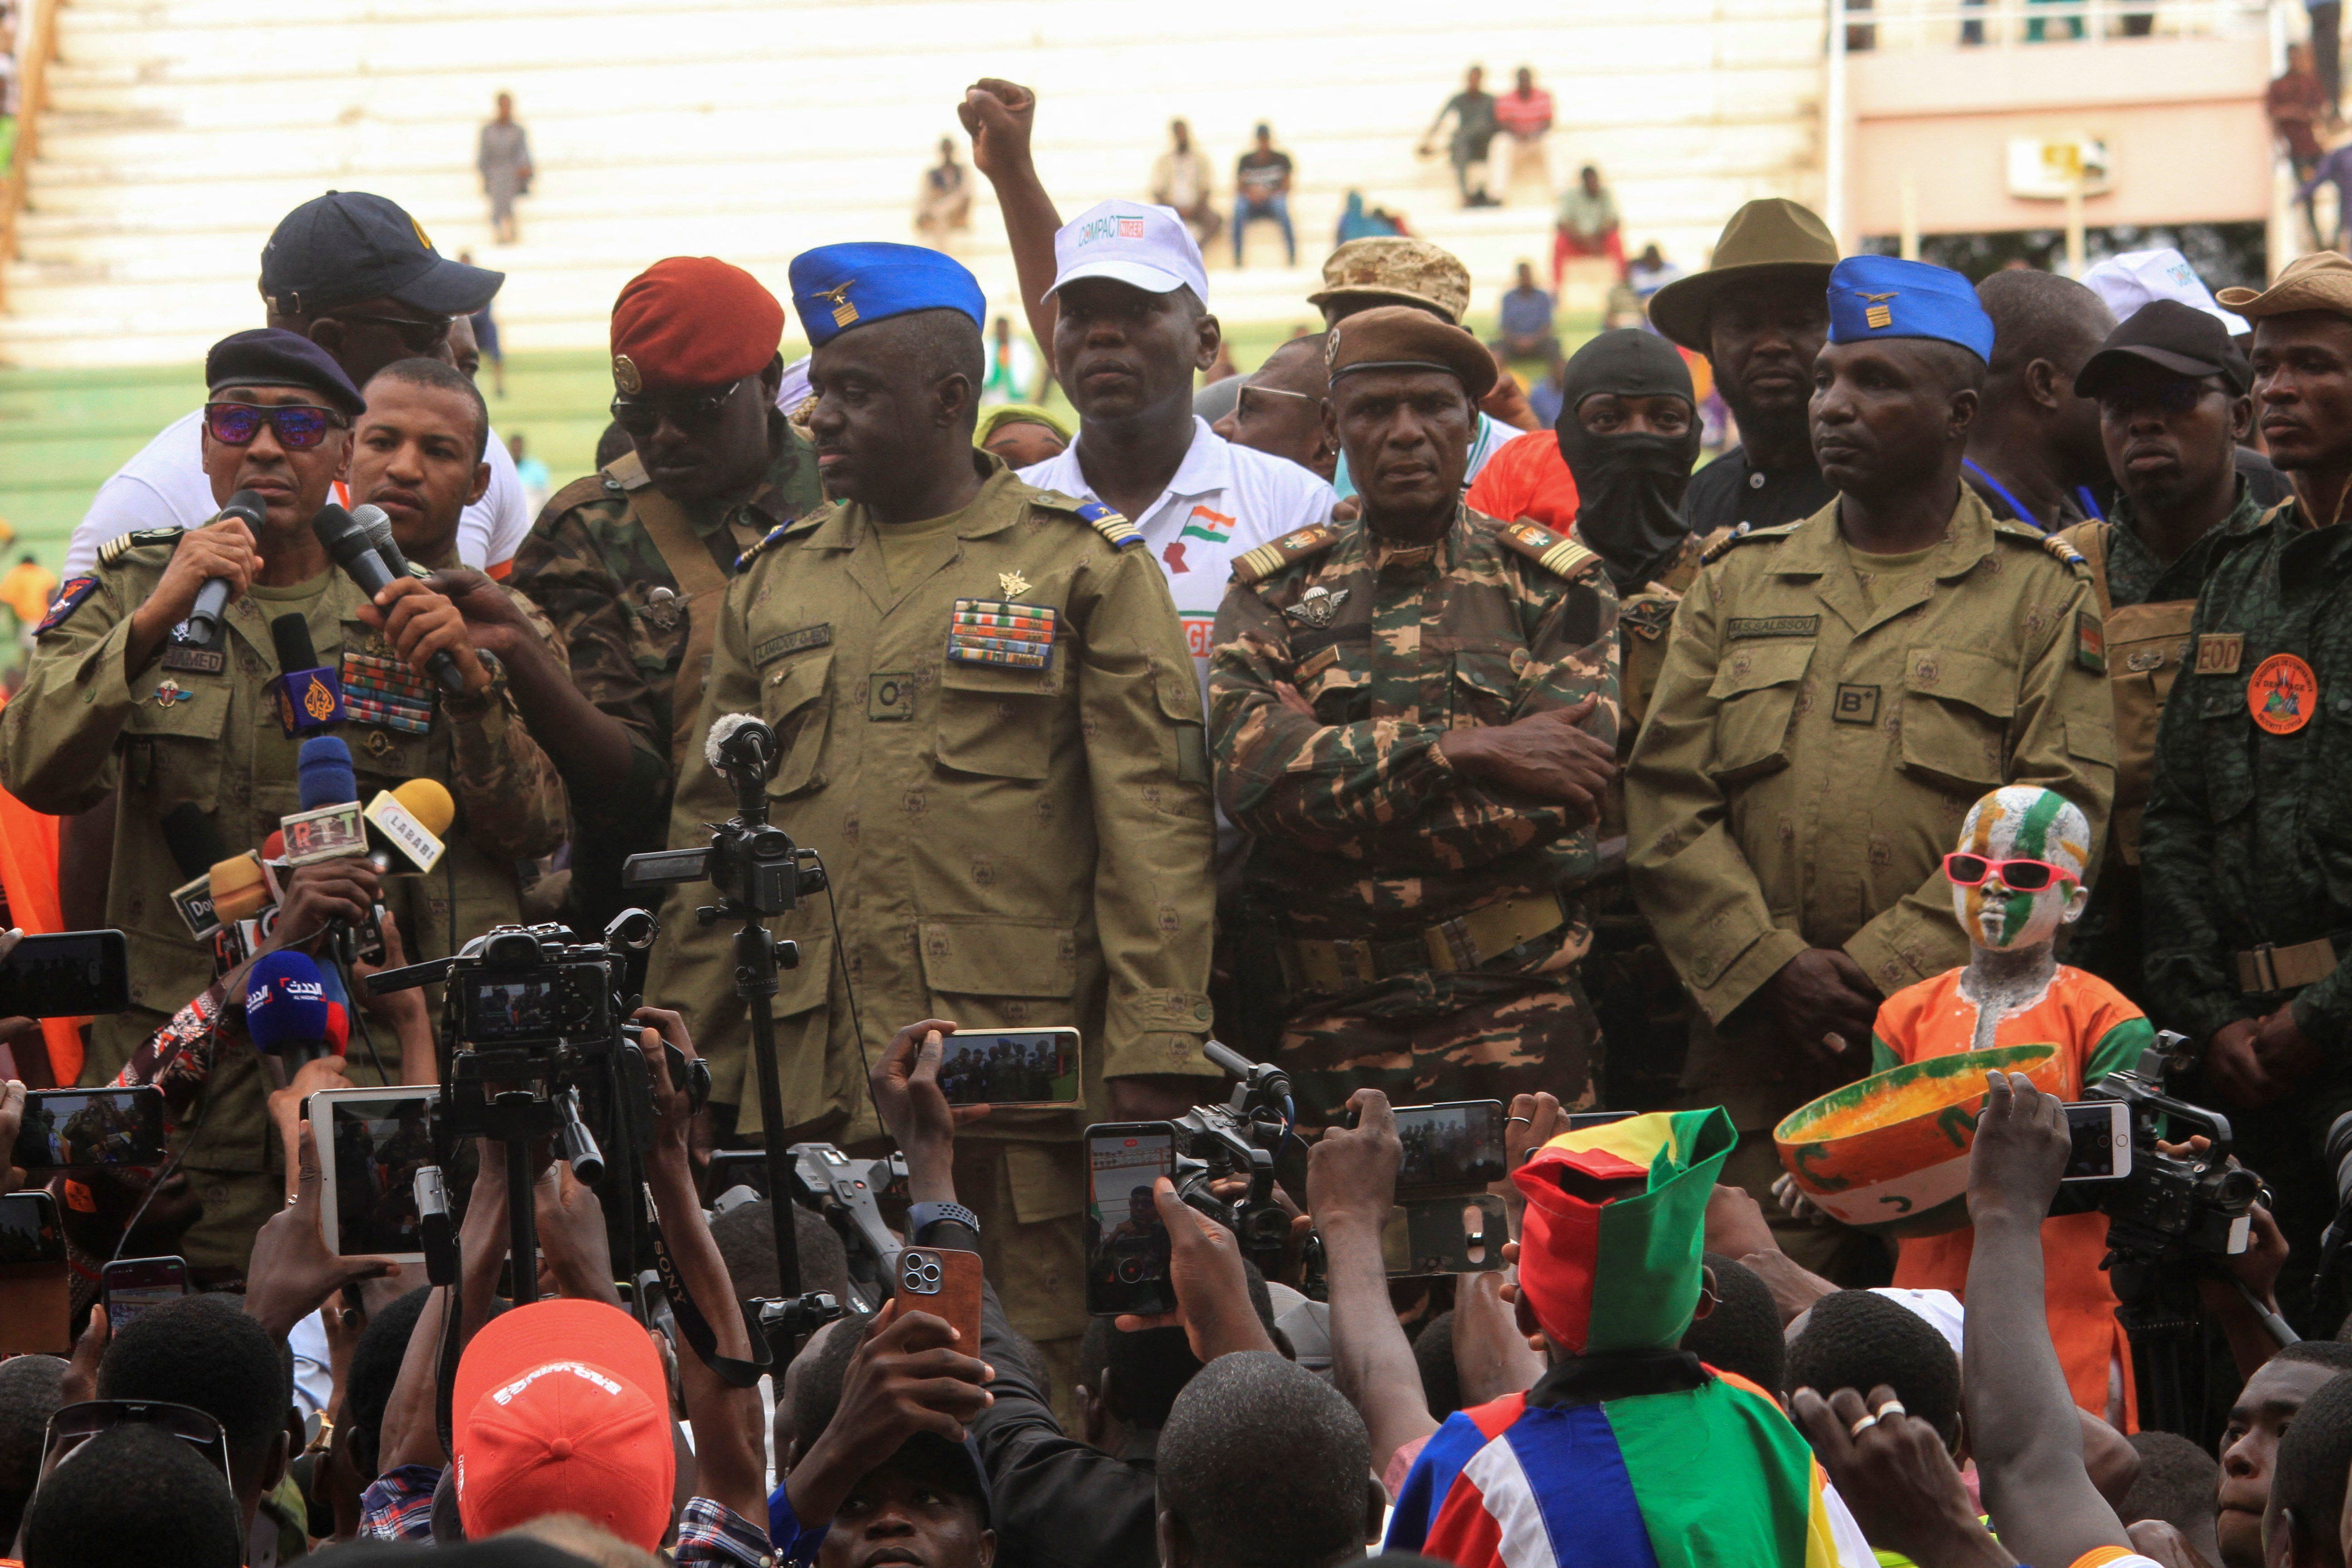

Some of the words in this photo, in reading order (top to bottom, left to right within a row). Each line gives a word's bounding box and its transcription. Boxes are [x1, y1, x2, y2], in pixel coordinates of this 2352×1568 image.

[1078, 215, 1122, 246] COMPACT
[1120, 220, 1143, 237] NIGER
[2199, 640, 2238, 669] EOD
[293, 811, 356, 848] RTT
[286, 980, 323, 995] الحدث
[654, 1240, 688, 1304] SONY
